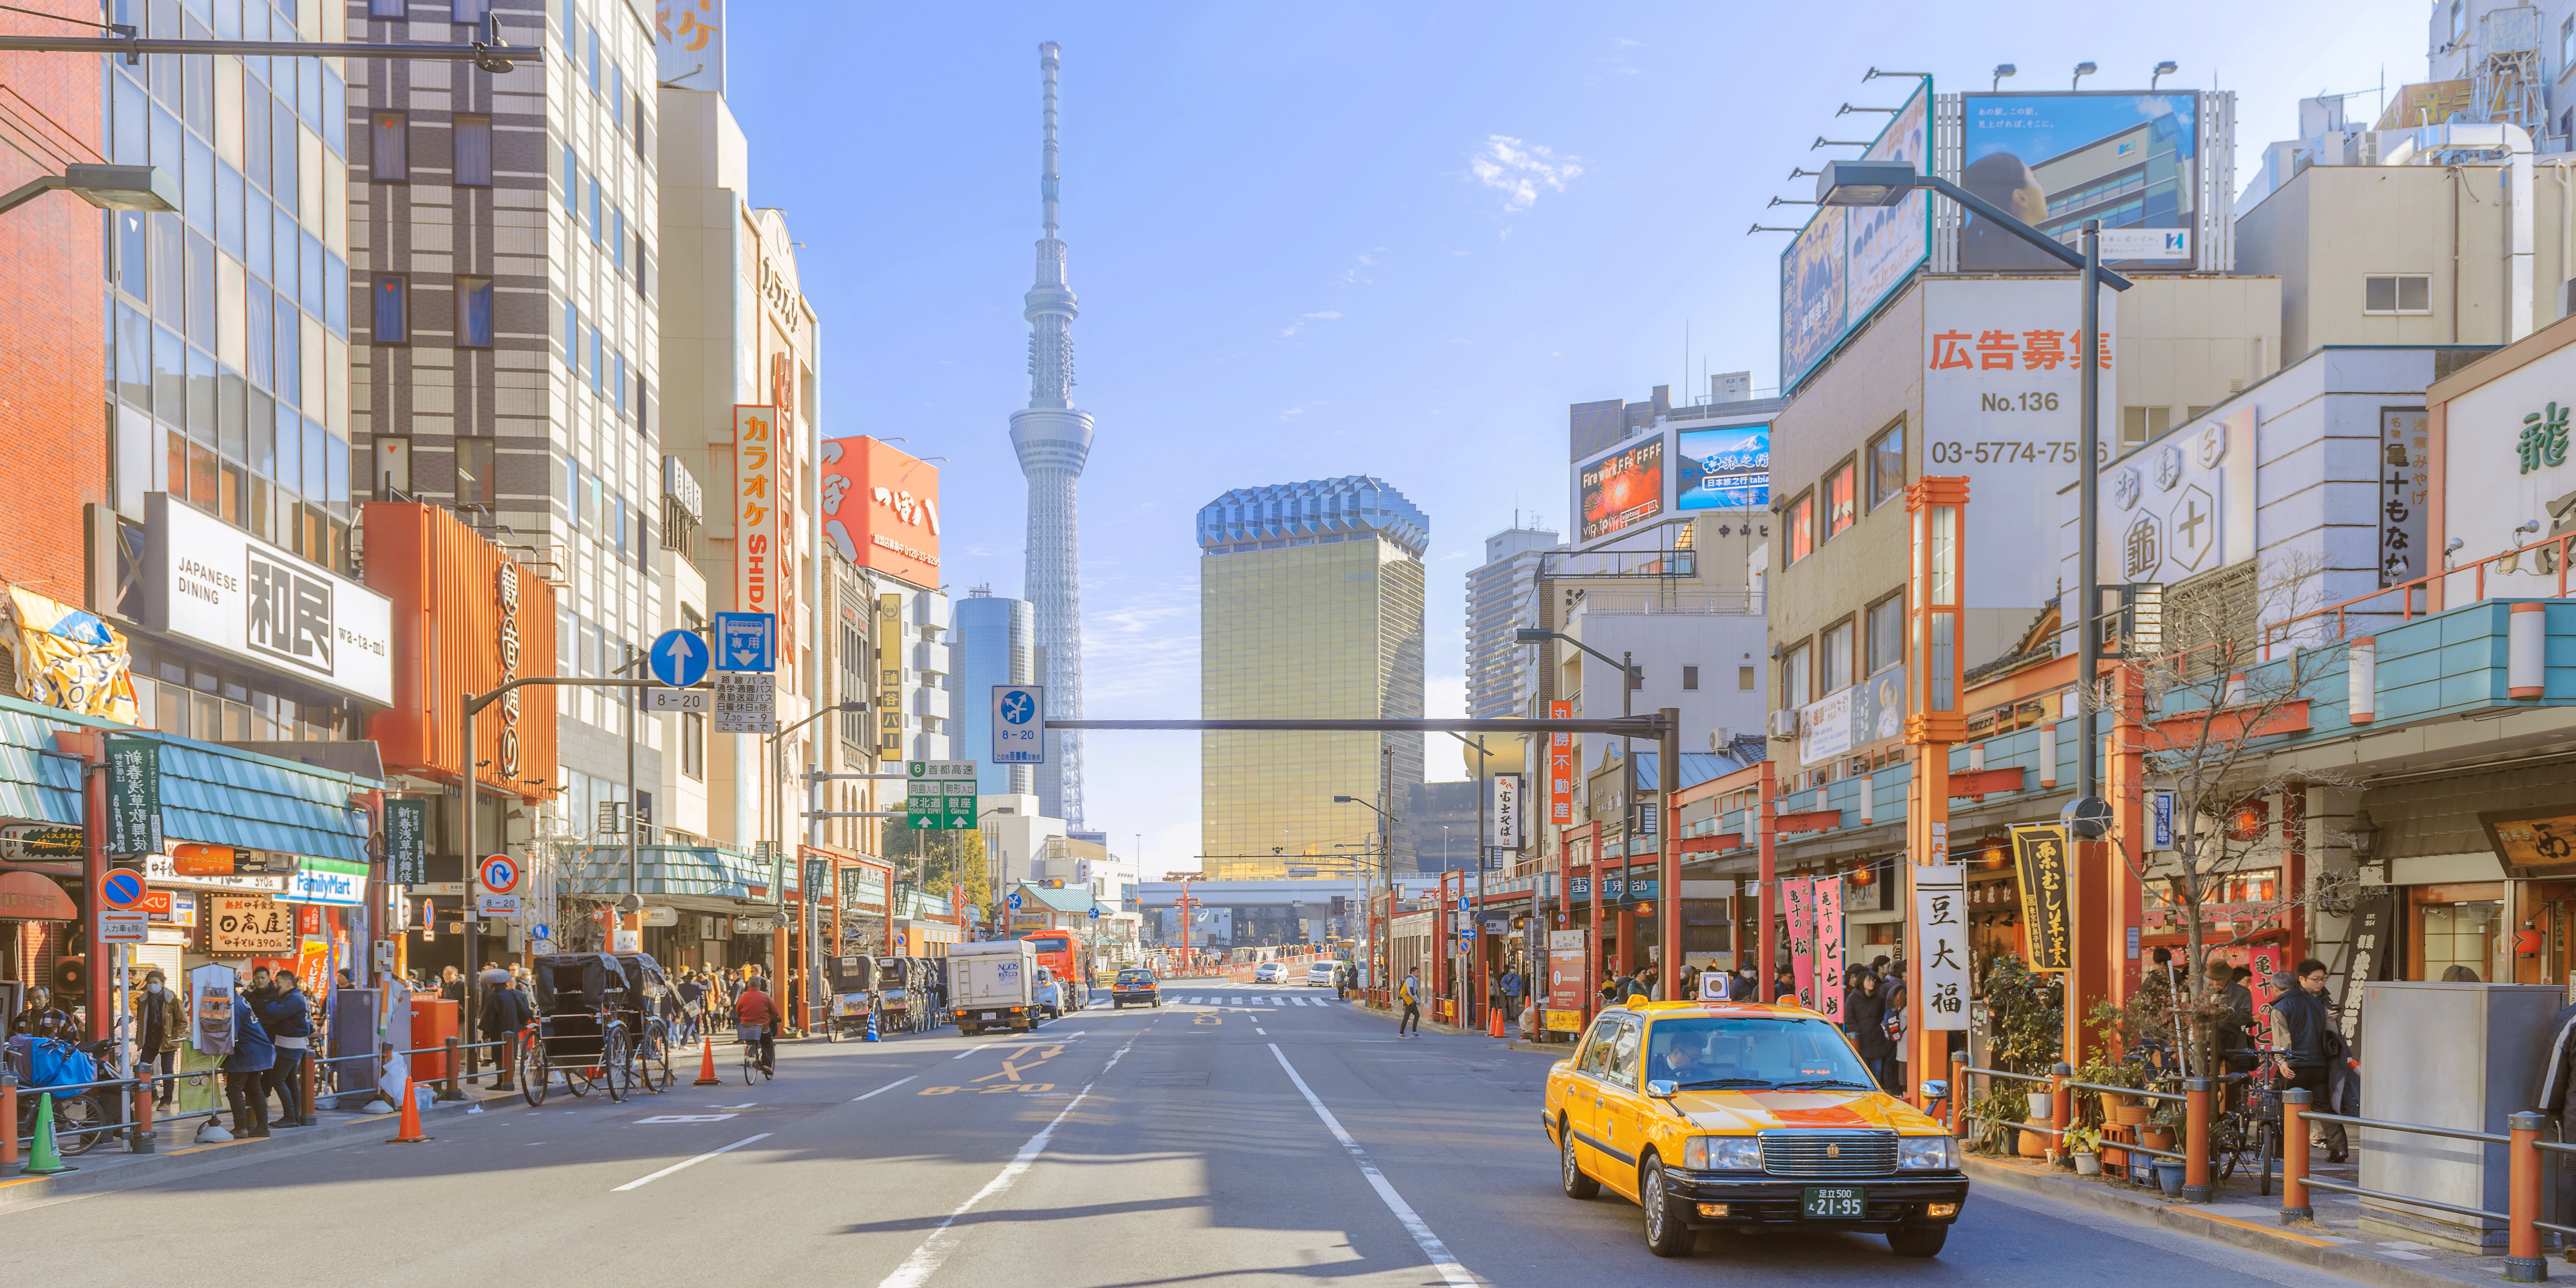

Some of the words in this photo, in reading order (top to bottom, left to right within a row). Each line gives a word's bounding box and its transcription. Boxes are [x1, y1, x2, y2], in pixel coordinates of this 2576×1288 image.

[676, 0, 718, 51] ケ
[1929, 329, 2113, 370] 広告募集
[1982, 391, 2059, 412] No.136
[2391, 417, 2402, 439] 名物
[1932, 441, 2108, 463] 03-5774-756
[2412, 418, 2428, 505] 浅草みやげ
[743, 416, 769, 527] カラオケ
[1707, 477, 1748, 487] 日本旅之行
[874, 533, 904, 553] 加盟店募集中
[905, 546, 940, 566] 0120-33-9295
[178, 557, 237, 593] JAPANESE
[178, 577, 219, 606] DINING
[251, 559, 329, 668] 和民
[338, 626, 385, 657] wa-ta-mi
[731, 637, 760, 649] 専用
[722, 676, 769, 684] 路線バス
[717, 694, 773, 702] 通勤送迎バス
[884, 671, 899, 748] 神谷バー
[722, 723, 768, 732] ここまで
[997, 751, 1040, 761] この先吾妻橋交差点
[1554, 708, 1569, 818] 丸勝不動産
[915, 764, 920, 773] 6
[929, 765, 973, 775] 首都高速
[911, 784, 938, 794] 向島入口
[946, 784, 973, 794] 駒形入口
[1500, 779, 1513, 789] 名代
[909, 798, 941, 808] 東北道
[949, 798, 971, 808] 銀座
[398, 806, 413, 882] 新春浅草歌舞伎
[298, 872, 350, 899] FamilyMart
[139, 897, 167, 909] くじ
[2036, 842, 2066, 966] 栗むし羊羹
[105, 924, 143, 933] 人力車を除く
[219, 913, 284, 934] 日高屋
[1928, 895, 1962, 1015] 豆大福
[1819, 1190, 1835, 1198] 足立
[1836, 1190, 1852, 1198] 500
[1817, 1199, 1861, 1215] 21-95
